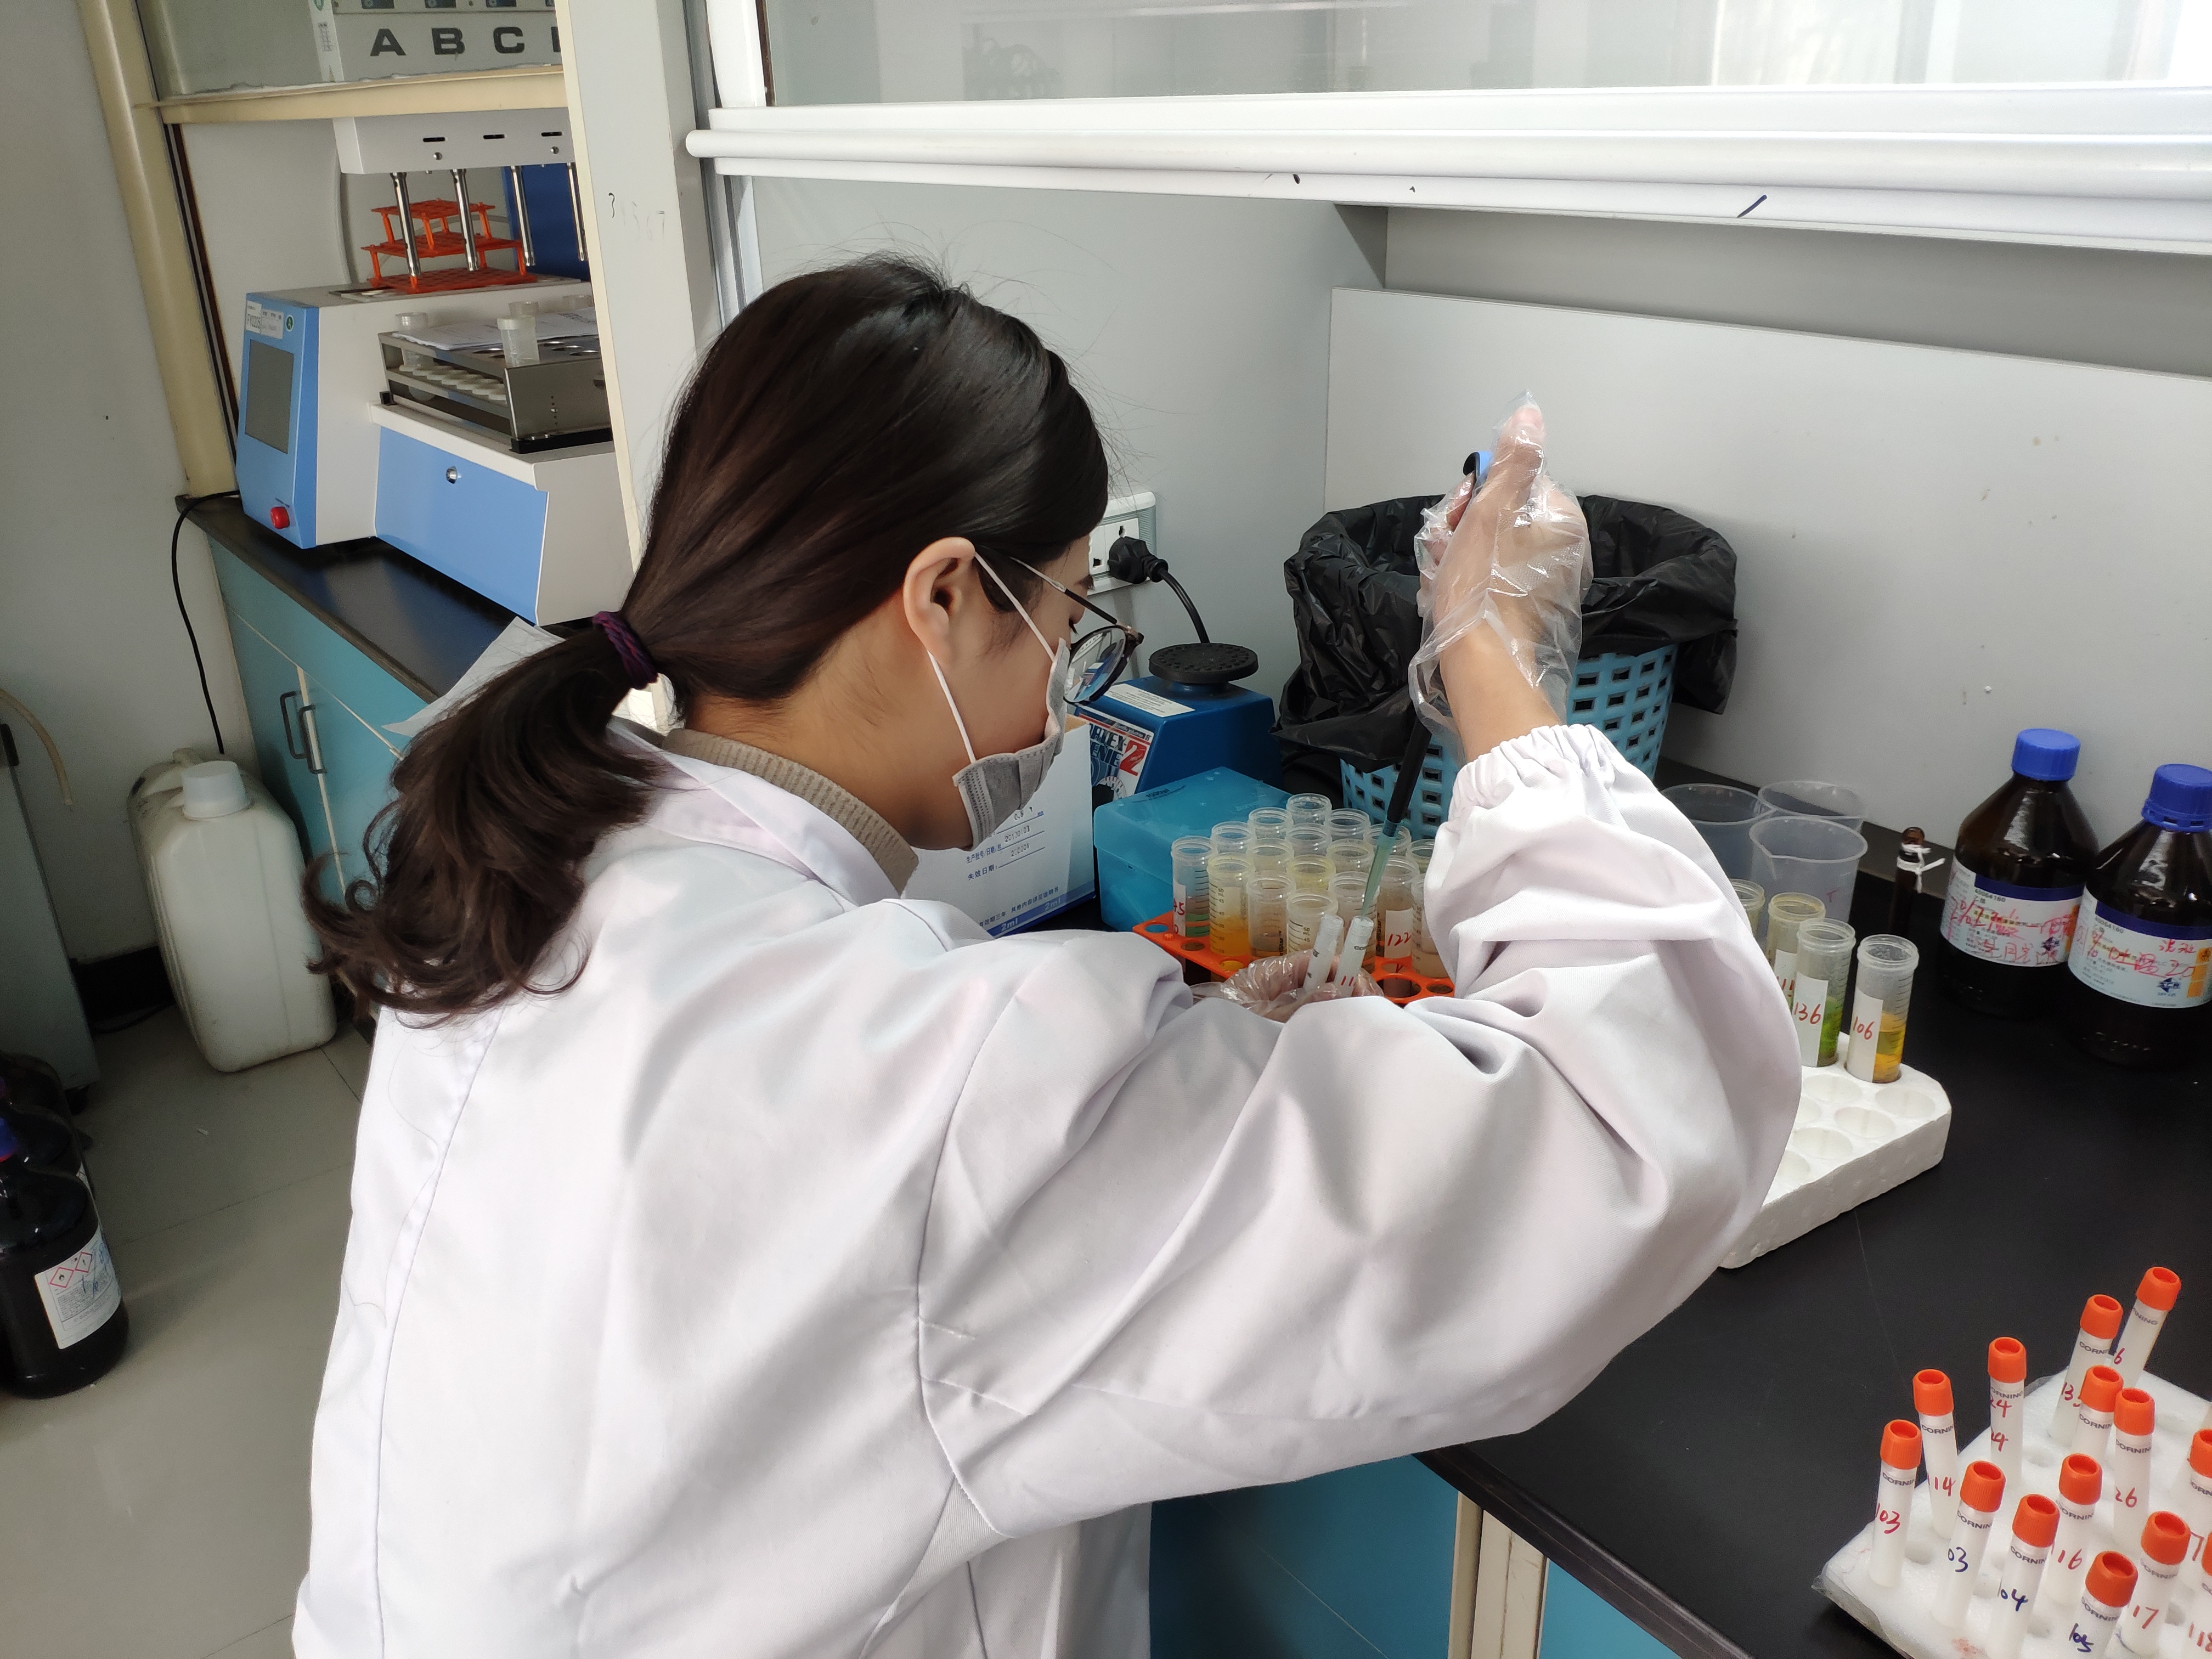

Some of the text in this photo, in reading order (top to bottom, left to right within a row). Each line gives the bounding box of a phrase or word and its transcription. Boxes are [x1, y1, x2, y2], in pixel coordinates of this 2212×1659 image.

[370, 27, 525, 56] A B C
[1119, 740, 1147, 776] 2
[1043, 897, 1062, 912] 2ml
[1001, 917, 1019, 932] 2ml
[1794, 1002, 1821, 1025] 136
[1853, 1016, 1875, 1040] 106
[2115, 1486, 2137, 1508] 26
